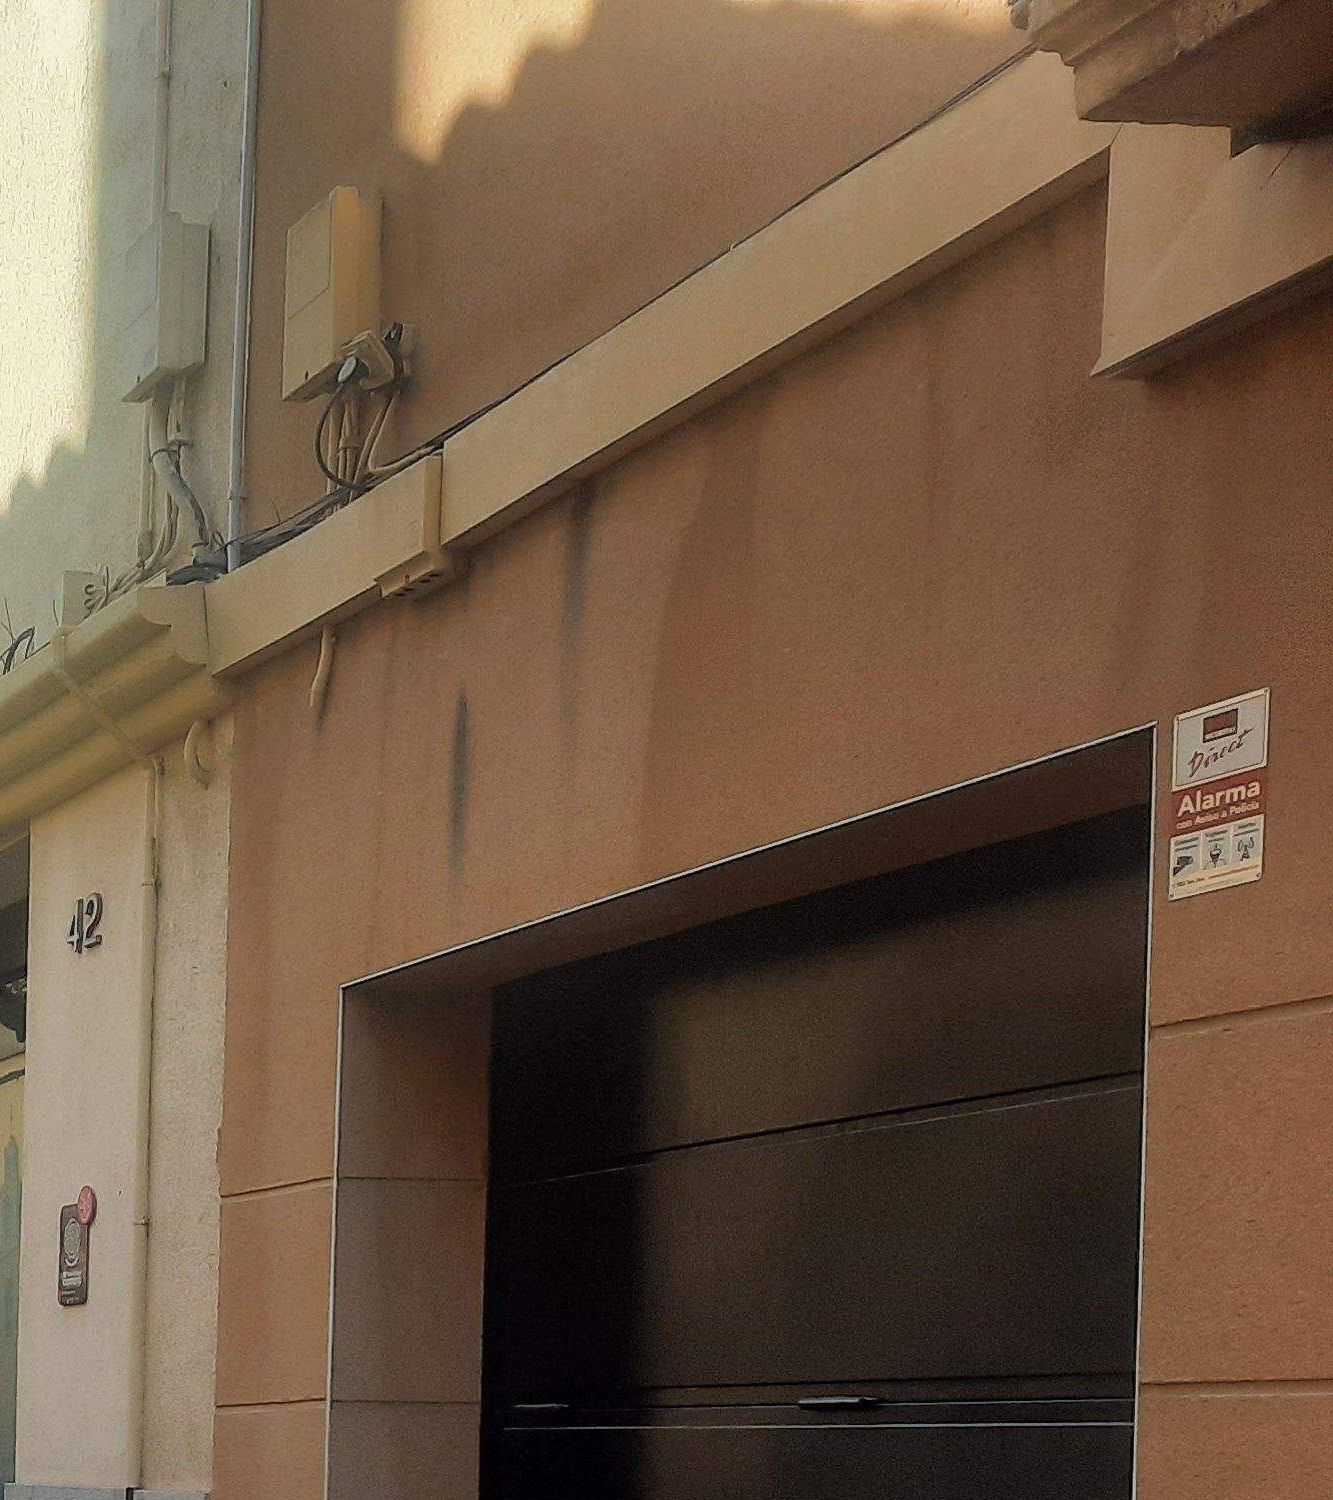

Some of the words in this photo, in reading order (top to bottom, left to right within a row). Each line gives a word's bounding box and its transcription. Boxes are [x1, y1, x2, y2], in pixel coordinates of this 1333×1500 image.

[1188, 728, 1254, 778] Direct
[1177, 781, 1261, 817] Alarma
[67, 893, 103, 954] 42
